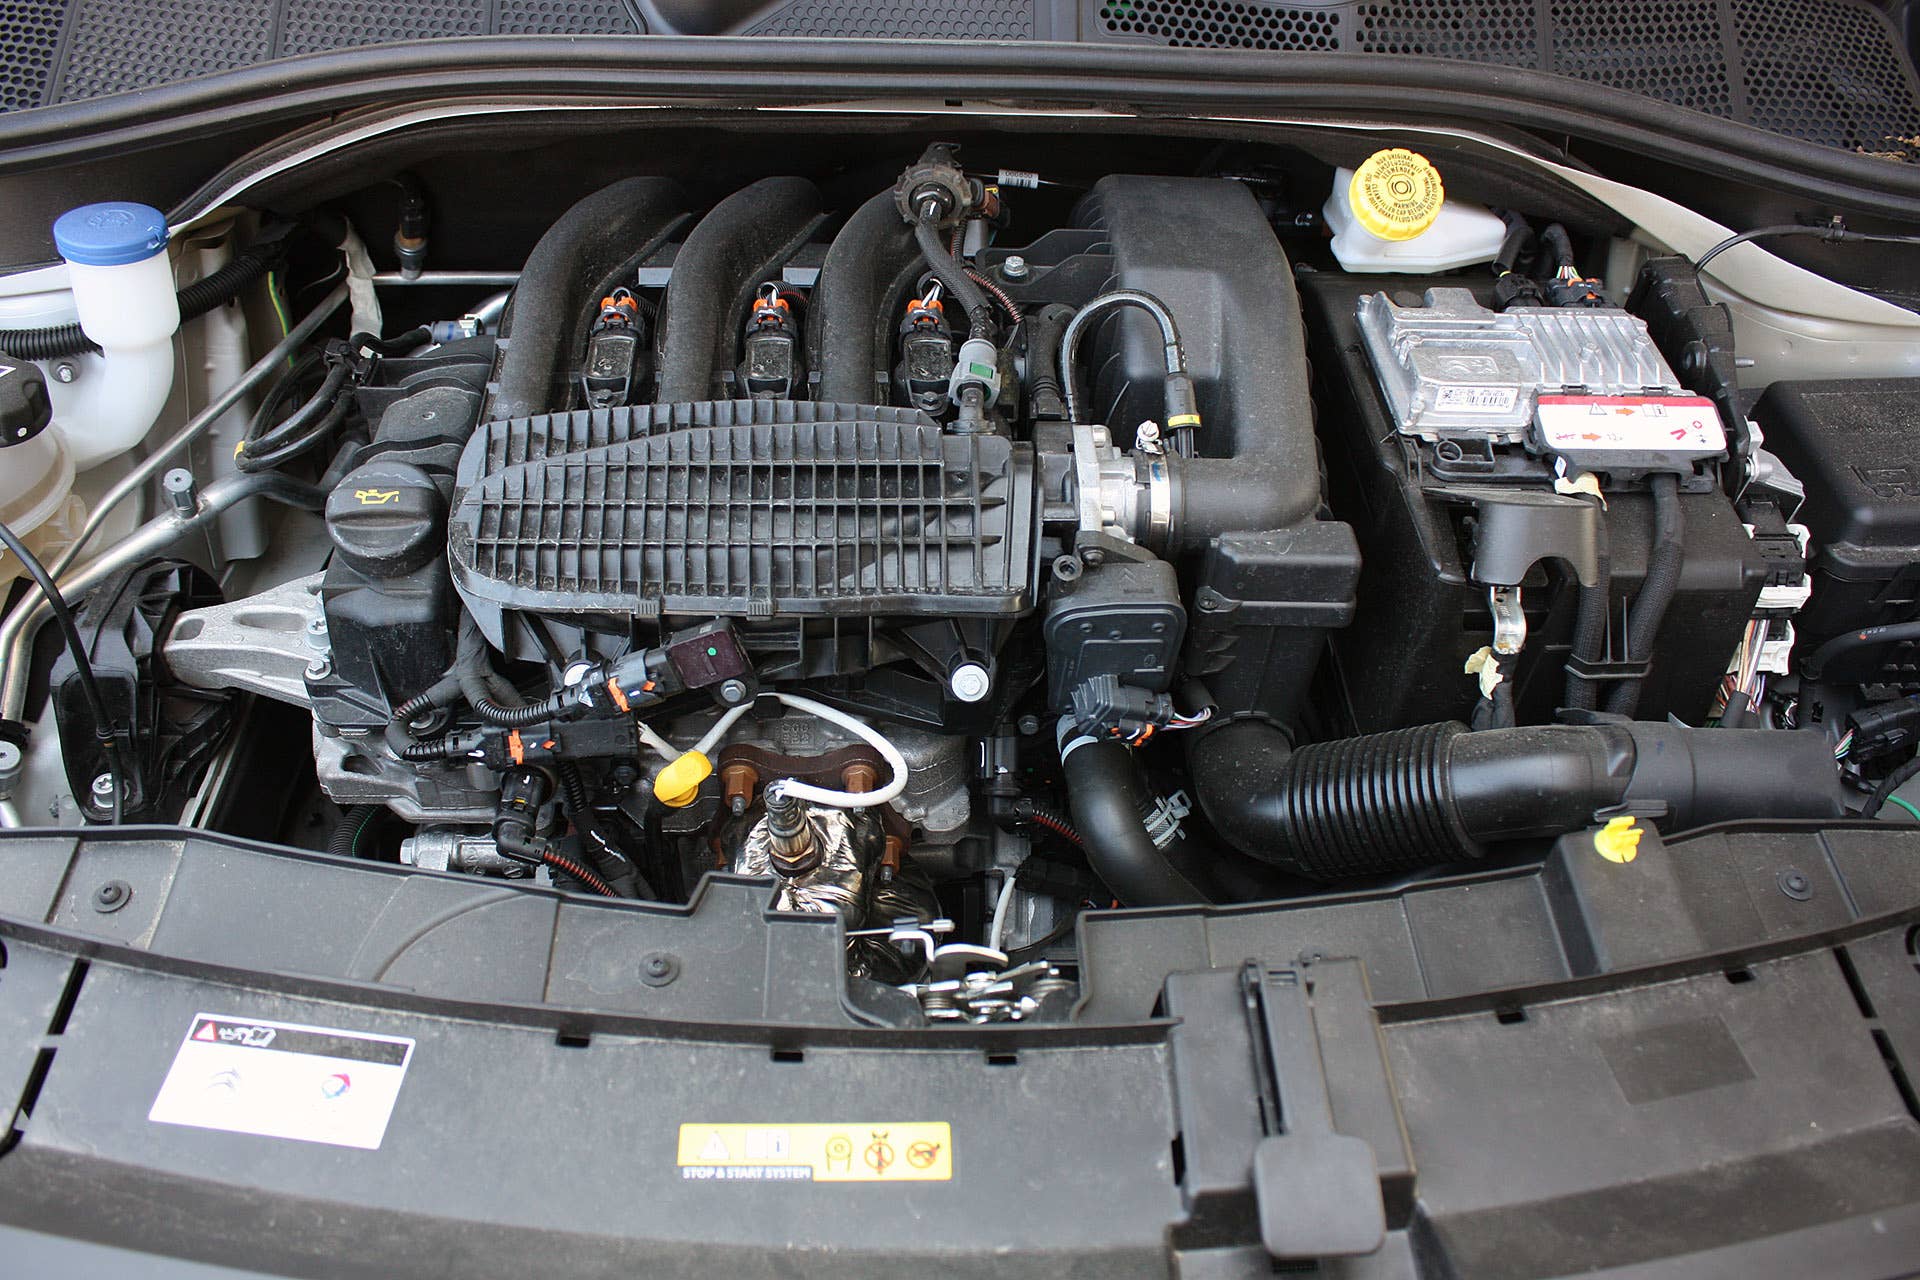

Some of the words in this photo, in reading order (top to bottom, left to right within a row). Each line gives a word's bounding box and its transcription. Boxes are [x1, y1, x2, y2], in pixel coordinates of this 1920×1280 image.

[683, 1166, 716, 1179] STOP
[716, 1166, 725, 1179] &
[727, 1166, 763, 1179] START
[765, 1166, 811, 1179] SYSTEM
